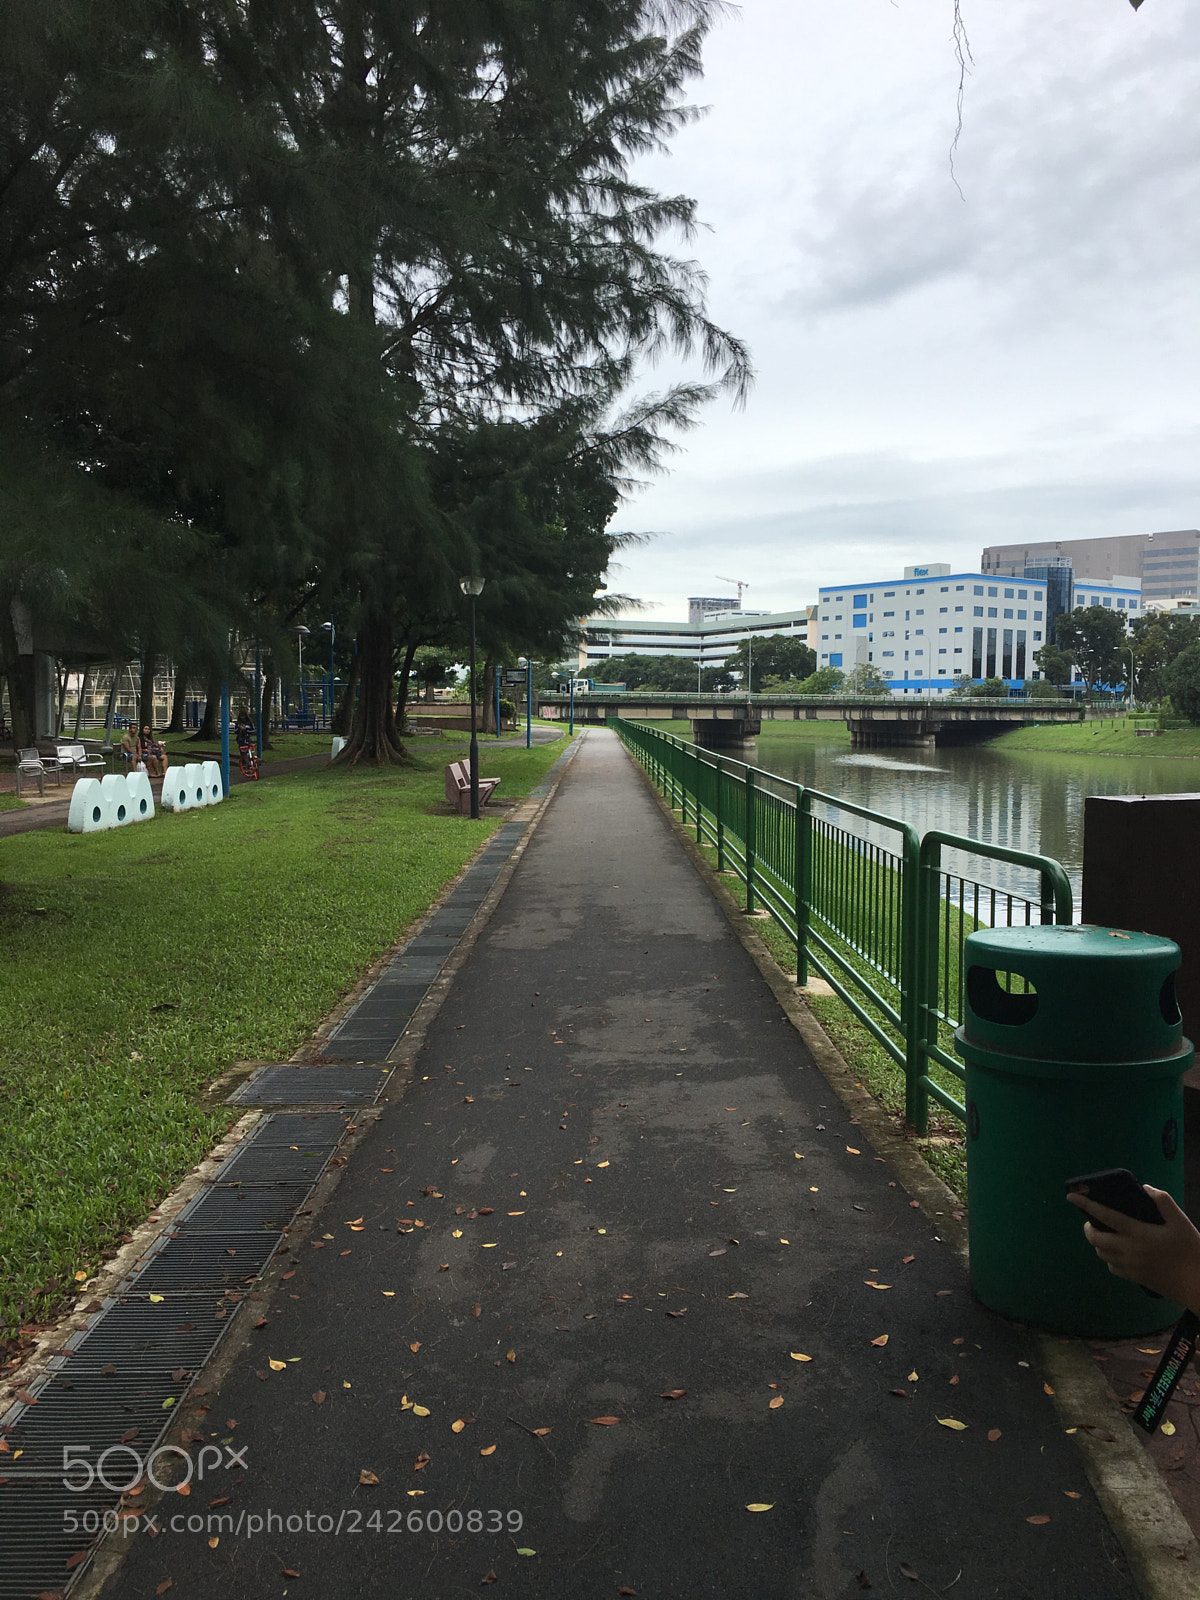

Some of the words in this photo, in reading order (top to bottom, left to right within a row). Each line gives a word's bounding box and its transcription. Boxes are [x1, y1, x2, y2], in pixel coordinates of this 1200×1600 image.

[914, 568, 929, 576] flex
[1173, 1338, 1192, 1360] LOVE
[1156, 1357, 1182, 1397] YOURSELF
